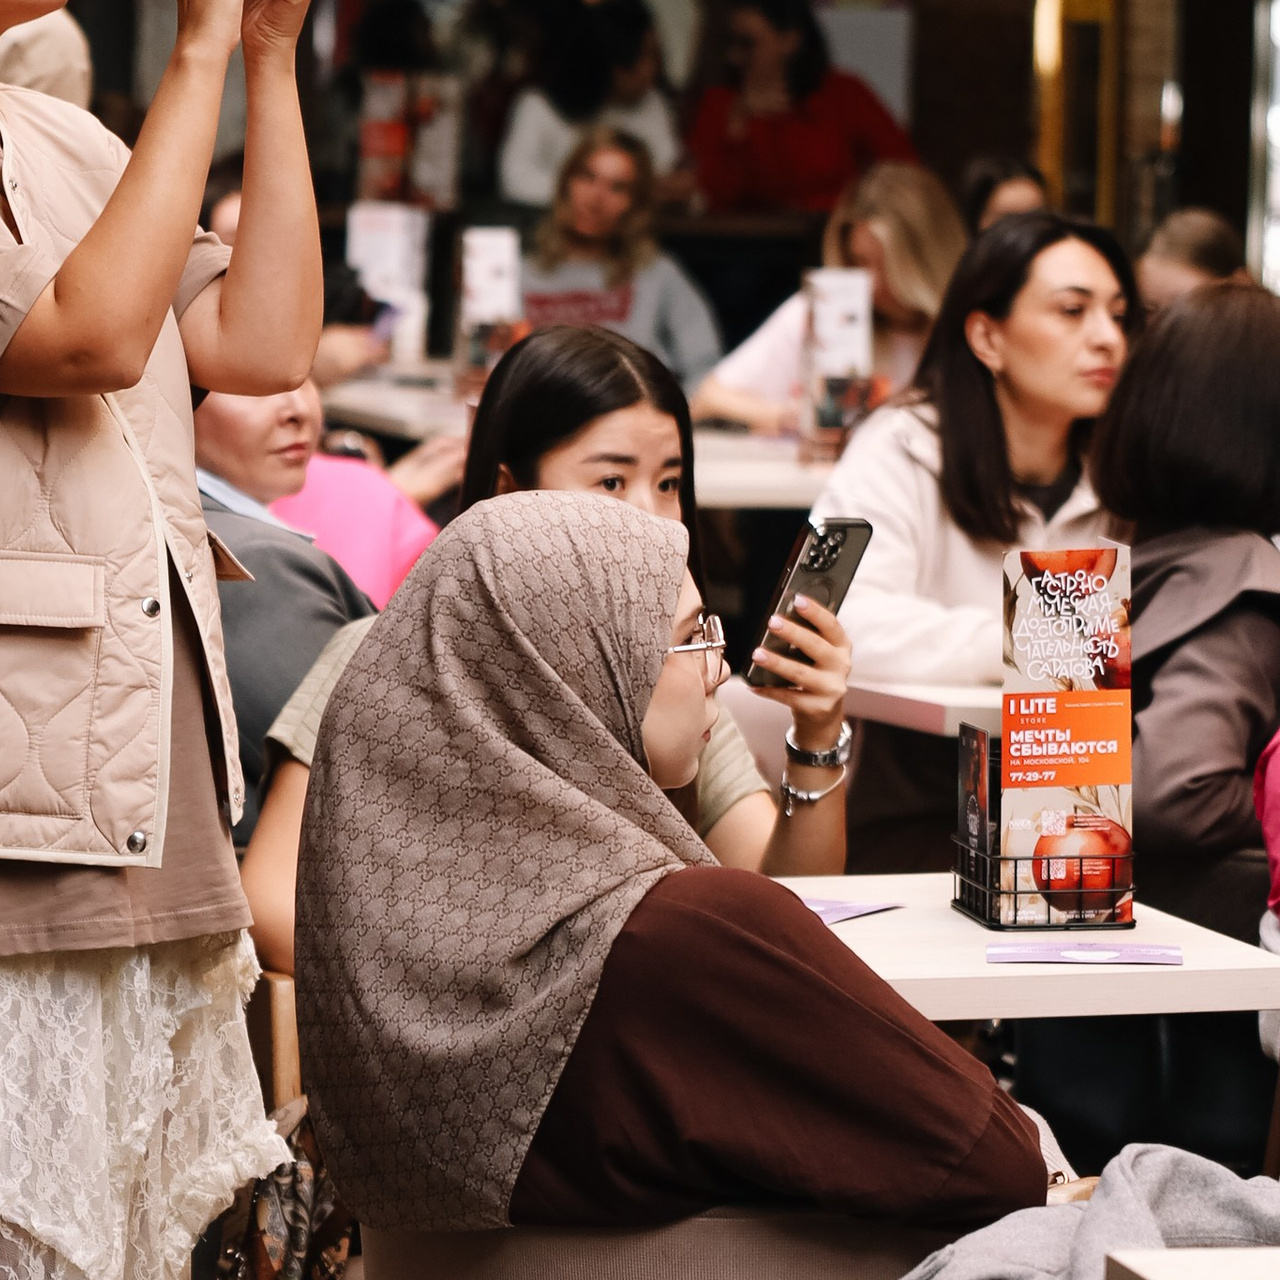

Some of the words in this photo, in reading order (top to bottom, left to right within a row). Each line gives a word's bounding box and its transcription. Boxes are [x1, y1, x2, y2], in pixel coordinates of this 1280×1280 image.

[1026, 656, 1105, 680] САРАТОВА
[1020, 697, 1057, 714] LITE
[1020, 717, 1046, 725] STORE
[1010, 729, 1071, 743] МЕЧТЫ
[1009, 740, 1118, 757] СБЫВАЮТСЯ
[1009, 771, 1056, 782] 77-29-77
